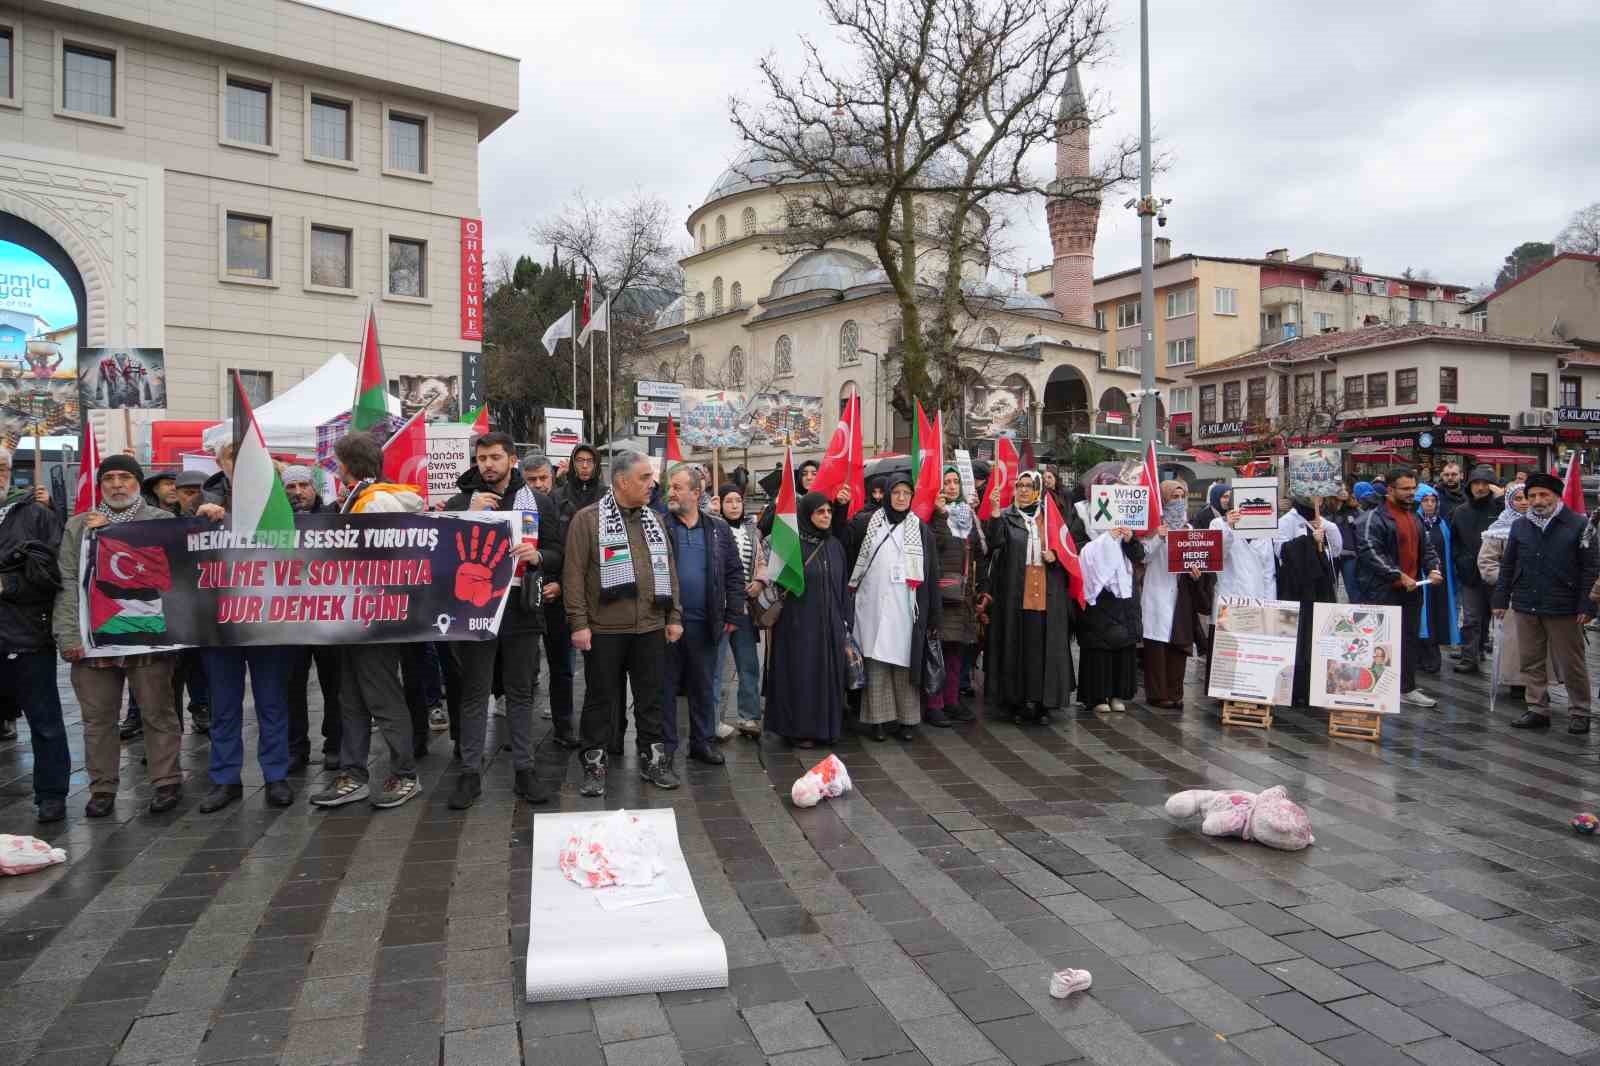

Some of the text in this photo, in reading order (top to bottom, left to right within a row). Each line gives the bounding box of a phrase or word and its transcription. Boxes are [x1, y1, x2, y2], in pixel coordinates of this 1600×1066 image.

[1114, 488, 1148, 499] WHO?
[1119, 505, 1144, 514] STOP
[303, 524, 360, 549] SESSİZ
[1188, 531, 1204, 540] BEN
[1182, 551, 1209, 560] HEDEF
[197, 559, 433, 590] ZULME VE SOYKIRIMA
[216, 586, 410, 631] DUR DEMEK İÇİN!
